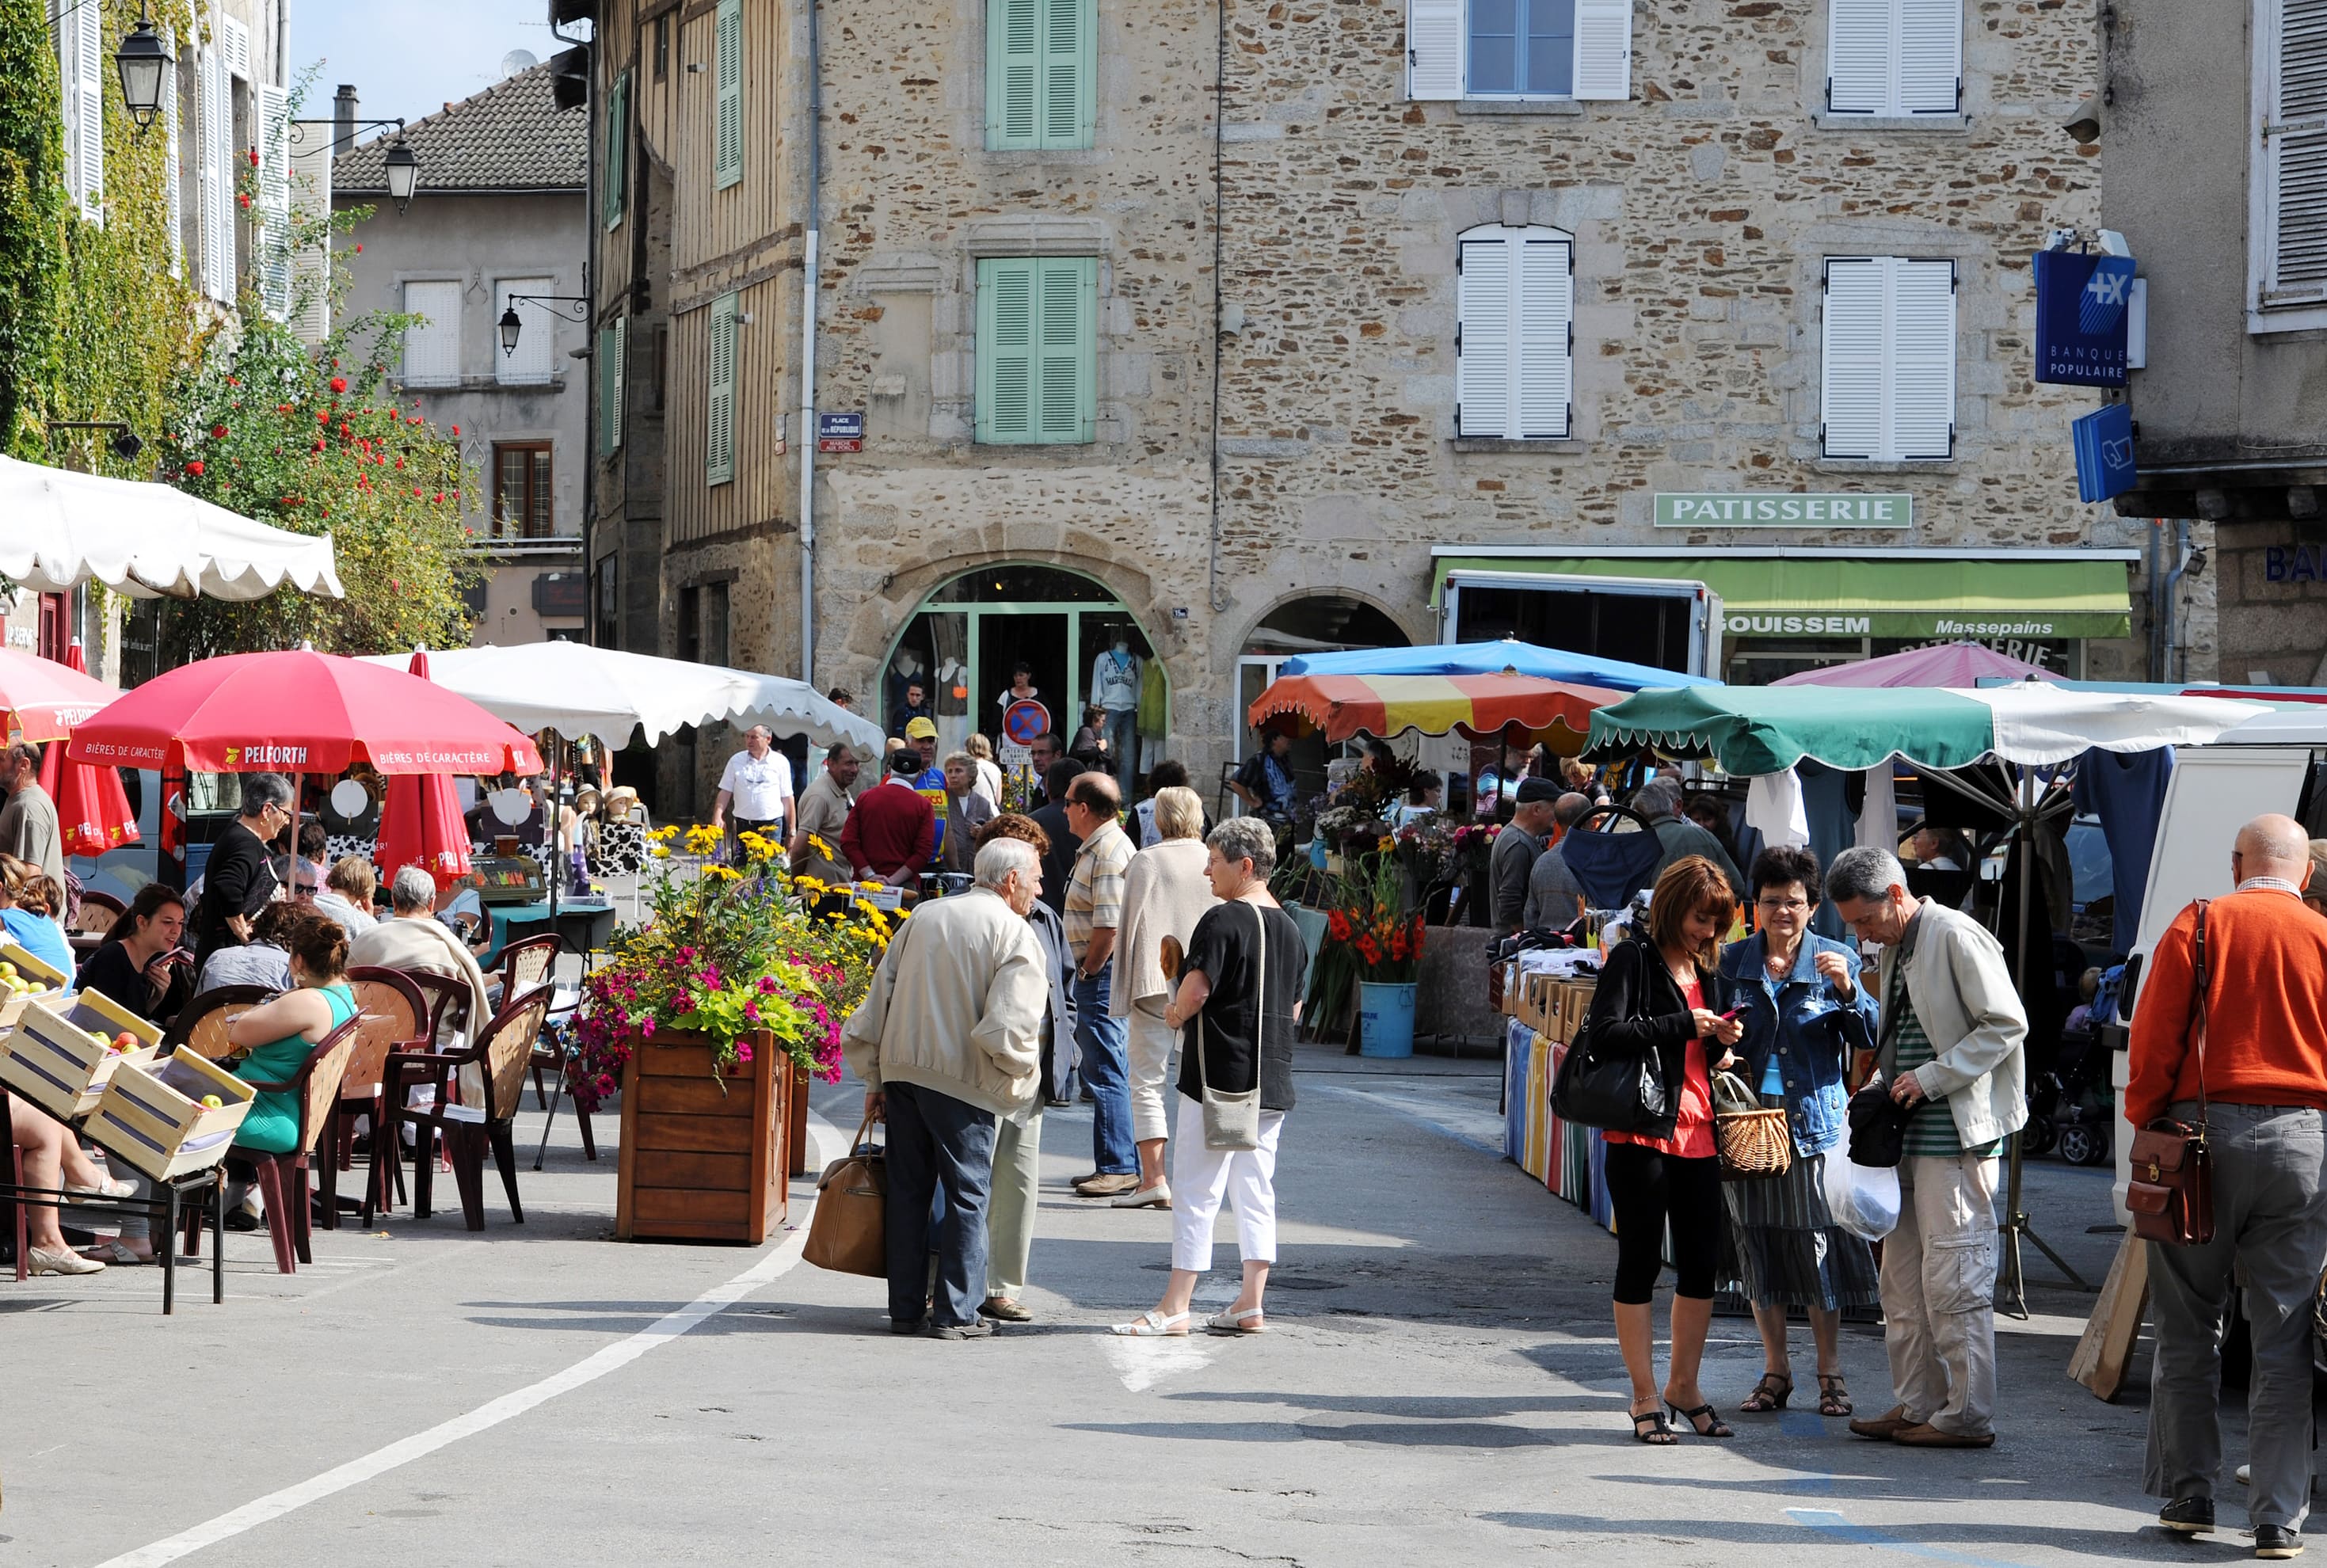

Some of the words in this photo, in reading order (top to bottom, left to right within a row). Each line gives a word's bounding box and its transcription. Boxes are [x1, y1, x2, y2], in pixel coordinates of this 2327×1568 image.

[2051, 345, 2123, 360] BANQUE
[2051, 363, 2123, 378] POPULAIRE
[1673, 500, 1893, 520] PATISSERIE
[2265, 545, 2327, 583] BA
[1723, 616, 1870, 633] OUISSEM
[1935, 620, 2053, 636] Massepains
[63, 709, 101, 725] PELFO
[86, 742, 116, 755] BIÈRES
[118, 746, 129, 756] DE
[131, 746, 165, 759] CARACTÈRE
[245, 747, 307, 764] PELFORTH
[379, 752, 412, 764] BIÈRES
[416, 752, 430, 763] DE
[432, 751, 490, 763] CARACTÈRE
